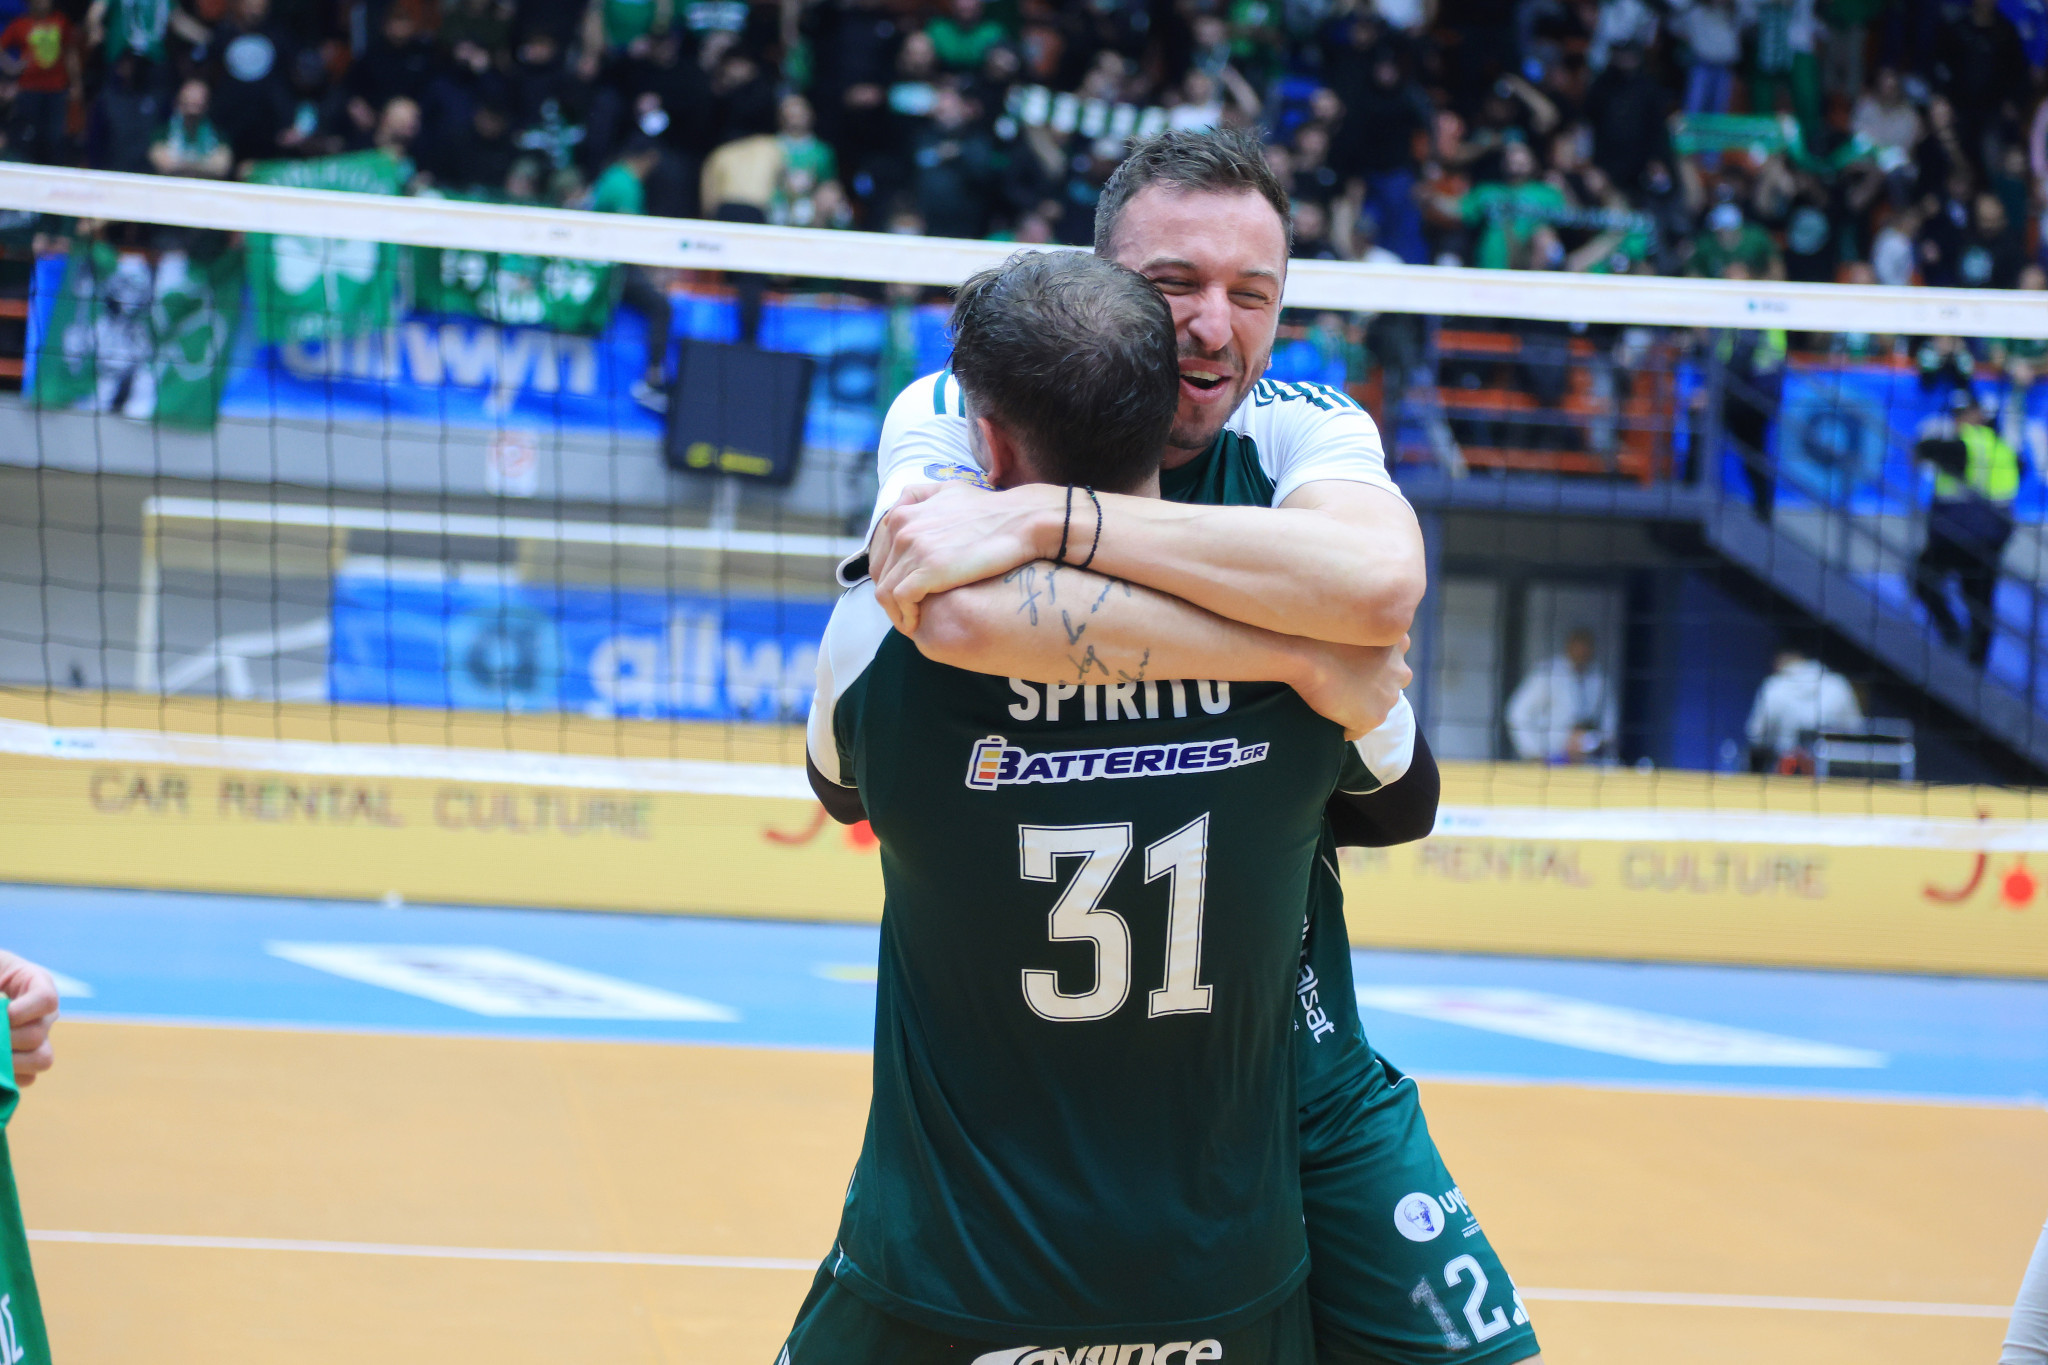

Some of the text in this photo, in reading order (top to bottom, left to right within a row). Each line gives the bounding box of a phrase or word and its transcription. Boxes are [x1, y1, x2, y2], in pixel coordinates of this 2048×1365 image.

[90, 767, 655, 842] CAR RENTAL CULTURE
[1418, 838, 1590, 891] RENTAL
[1620, 845, 1832, 901] CULTURE
[1018, 811, 1213, 1022] 31
